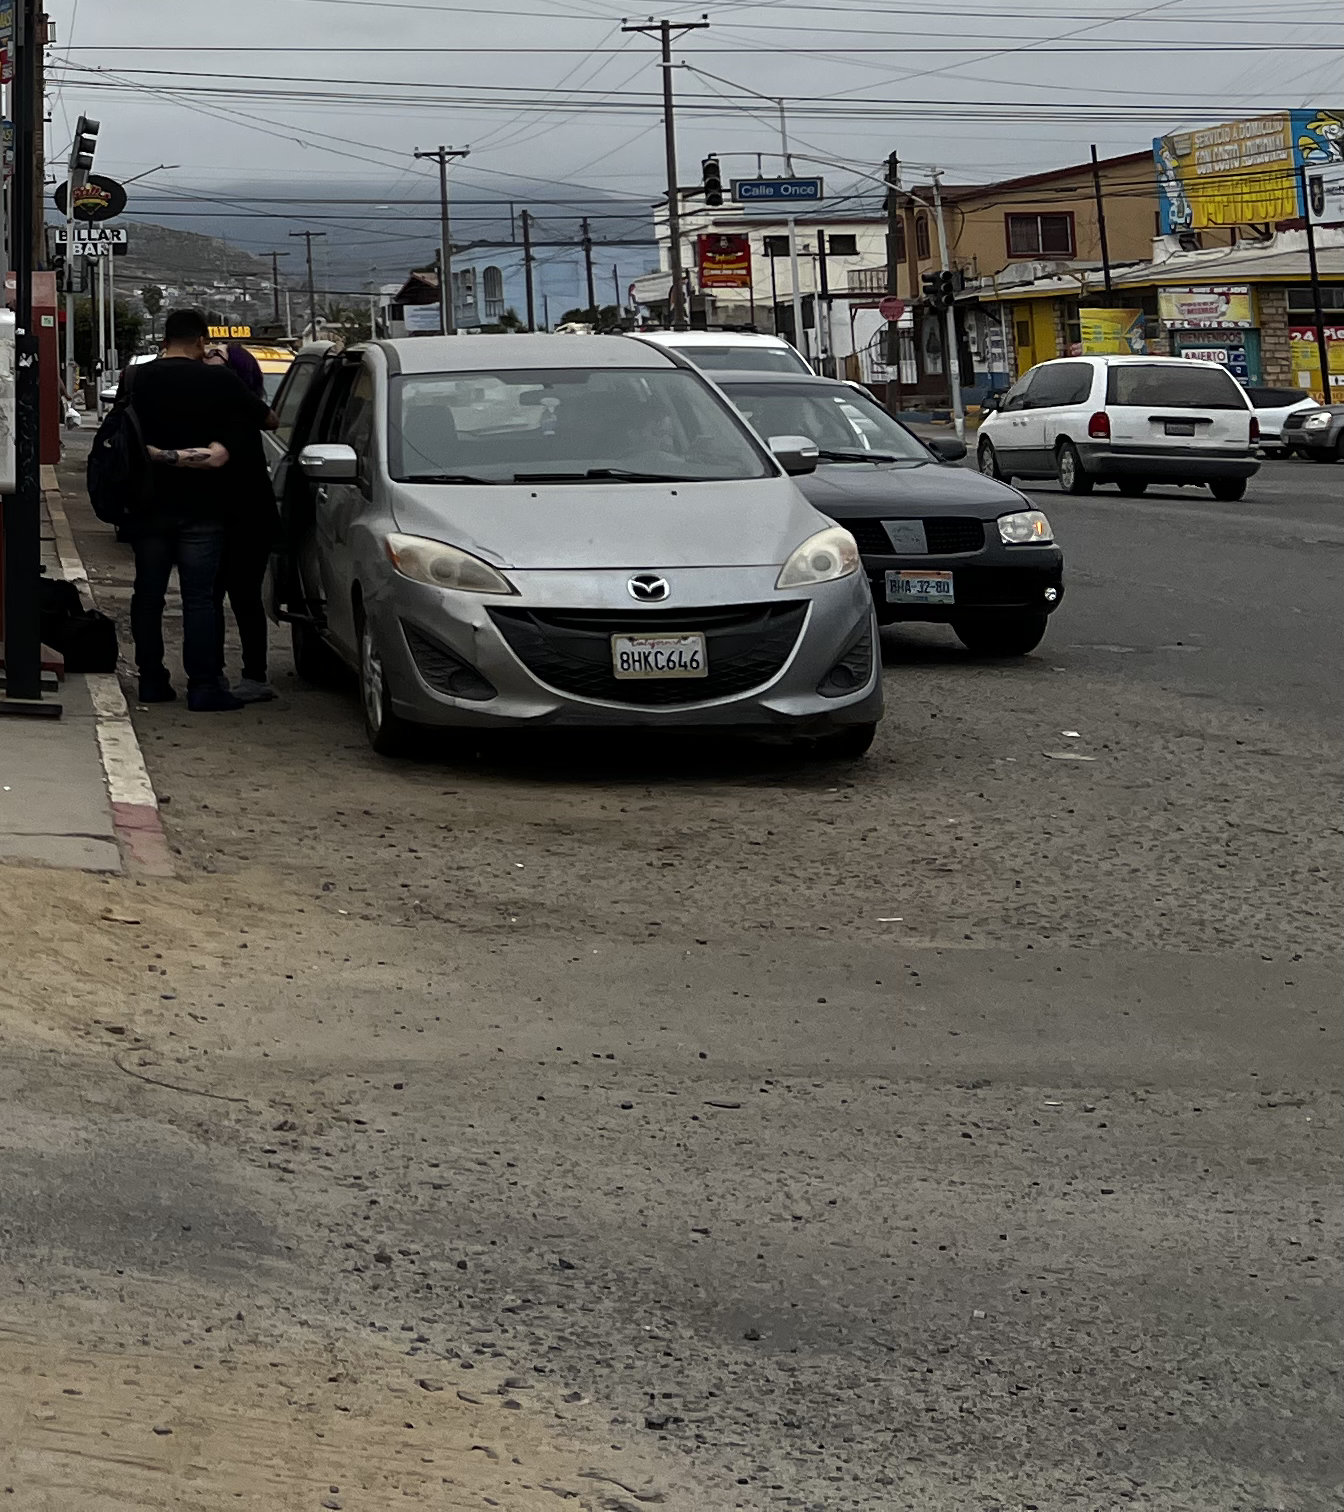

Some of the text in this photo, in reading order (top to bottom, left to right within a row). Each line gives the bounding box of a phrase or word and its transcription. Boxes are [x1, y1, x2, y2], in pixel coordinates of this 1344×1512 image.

[741, 184, 815, 196] Calle Once
[58, 229, 122, 242] BILLAR
[73, 243, 110, 256] BAR
[207, 326, 251, 338] TAXI CAB
[1184, 350, 1226, 362] ABIERTO
[620, 649, 700, 672] 8HKC646
